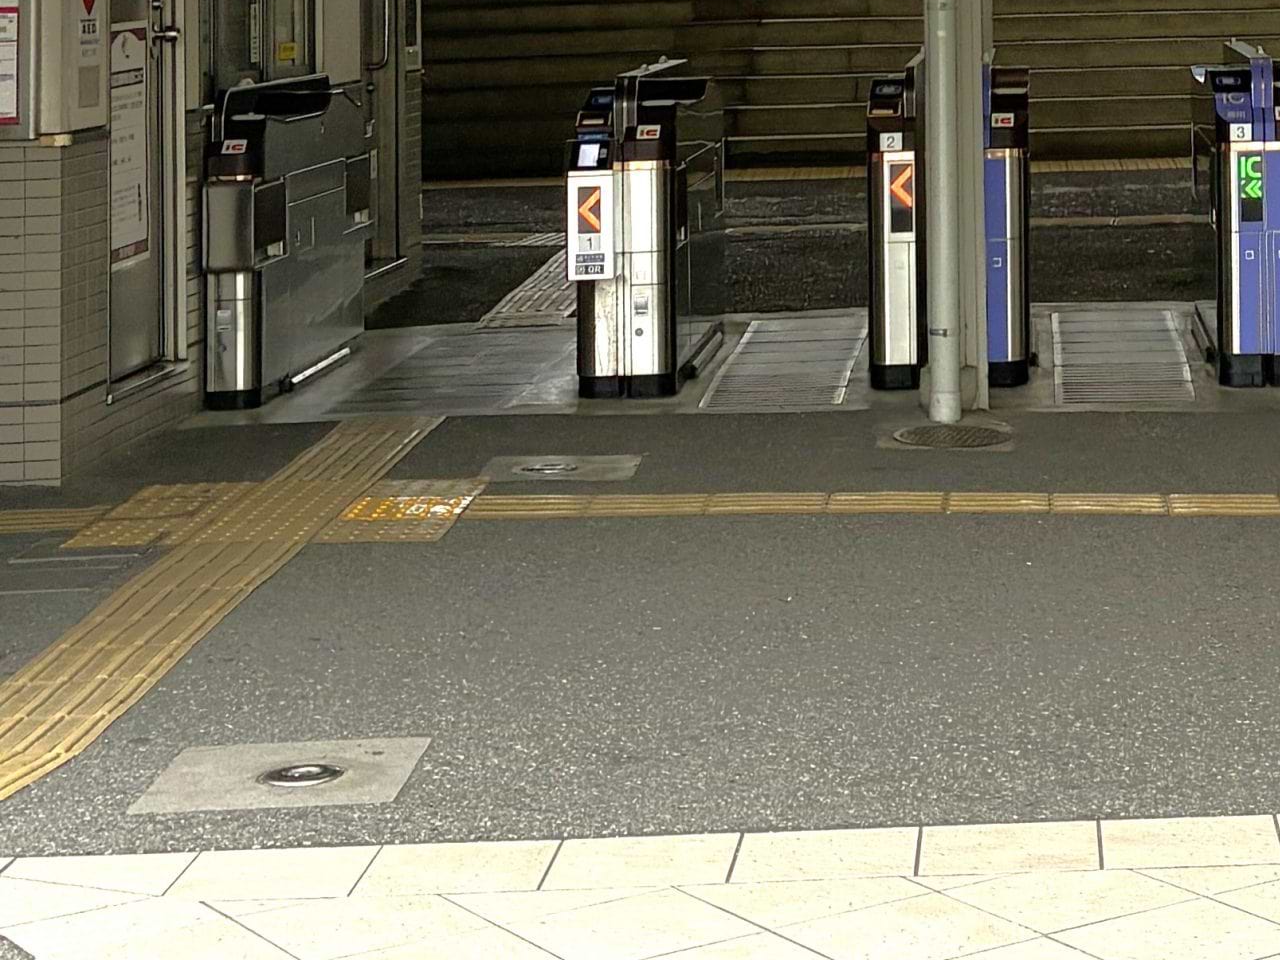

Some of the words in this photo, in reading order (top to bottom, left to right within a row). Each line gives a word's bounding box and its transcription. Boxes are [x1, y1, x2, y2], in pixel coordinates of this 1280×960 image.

[1236, 126, 1246, 139] 3
[886, 136, 895, 149] 2
[1240, 156, 1262, 178] IC
